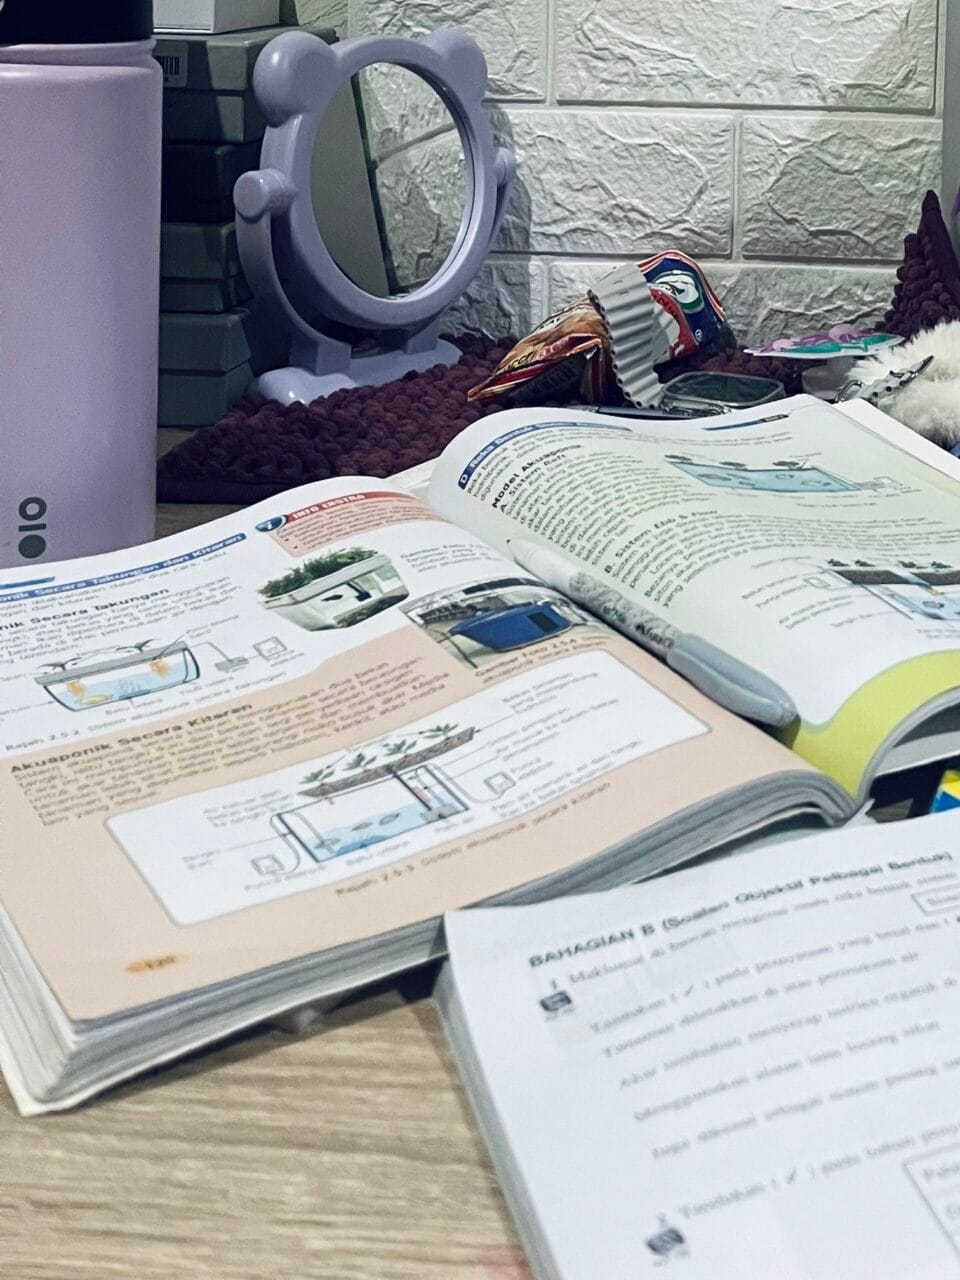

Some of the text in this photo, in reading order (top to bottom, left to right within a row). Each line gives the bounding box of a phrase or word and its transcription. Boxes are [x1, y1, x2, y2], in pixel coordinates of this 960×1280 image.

[492, 472, 520, 509] Model
[509, 467, 542, 496] Sistem
[615, 528, 652, 559] Sistem
[34, 580, 88, 597] Secara
[192, 535, 243, 559] Kitaran
[30, 608, 88, 624] Secara
[95, 588, 170, 611] Takungan
[11, 704, 252, 773] Akuaponik Secara Kitaran
[528, 926, 635, 968] BAHAGIAN
[641, 923, 655, 936] B
